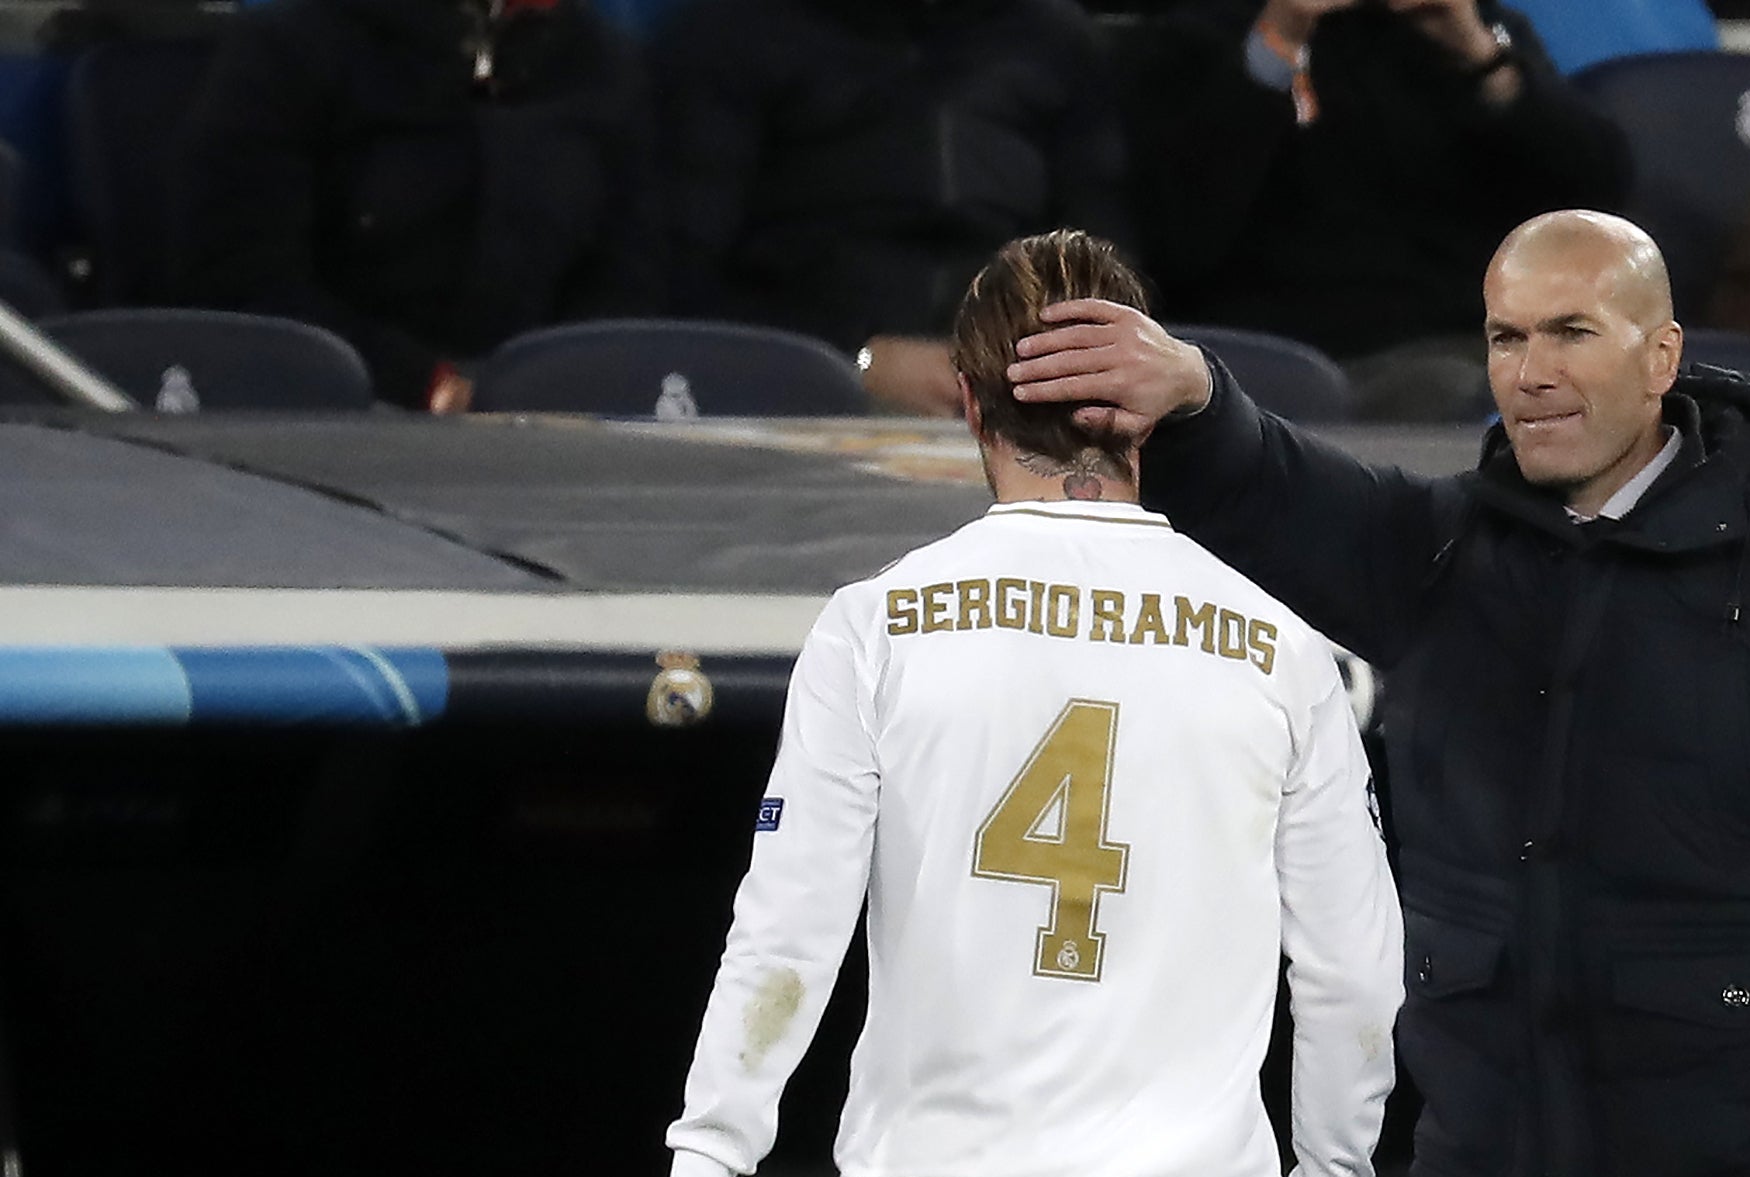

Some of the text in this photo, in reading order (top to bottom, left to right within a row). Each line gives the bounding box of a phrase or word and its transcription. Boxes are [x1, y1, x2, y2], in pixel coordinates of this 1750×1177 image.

[886, 577, 1278, 677] SERGIO RAMOS
[970, 697, 1130, 983] 4
